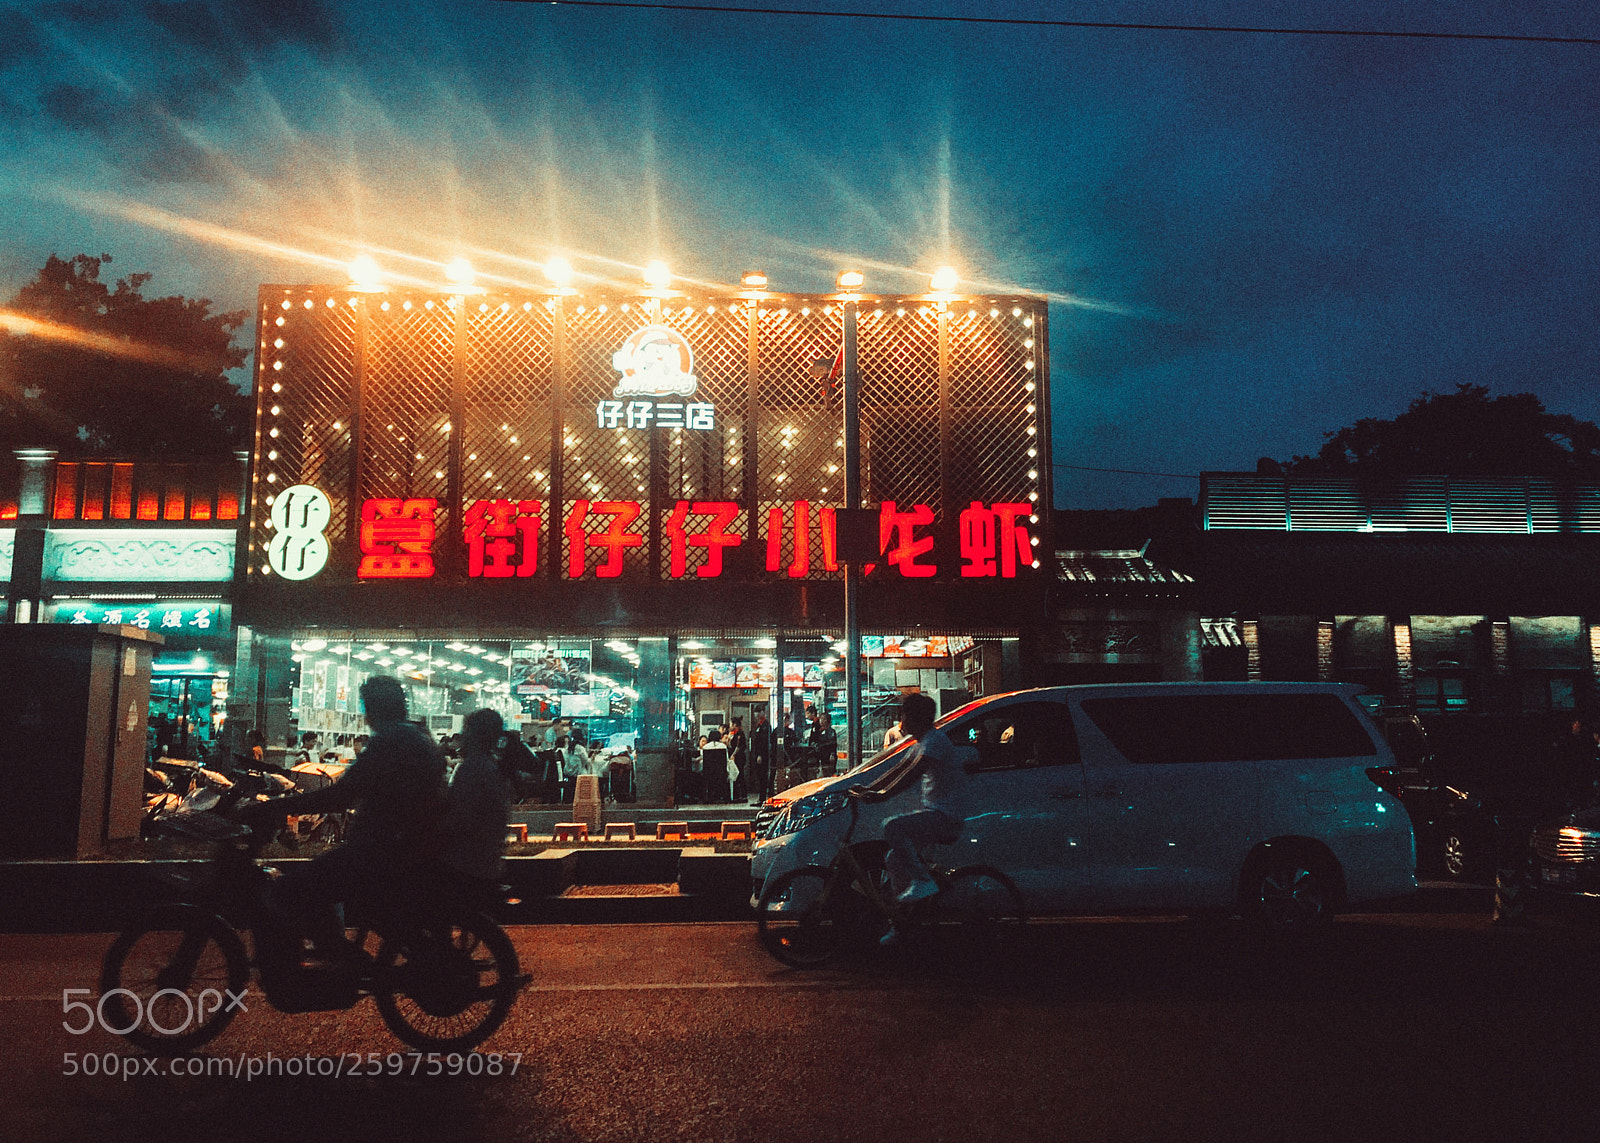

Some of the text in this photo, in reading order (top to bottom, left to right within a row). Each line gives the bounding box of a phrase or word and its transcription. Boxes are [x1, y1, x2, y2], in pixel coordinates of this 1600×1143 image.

[596, 400, 715, 430] 仔仔三店
[278, 492, 320, 572] 仔仔
